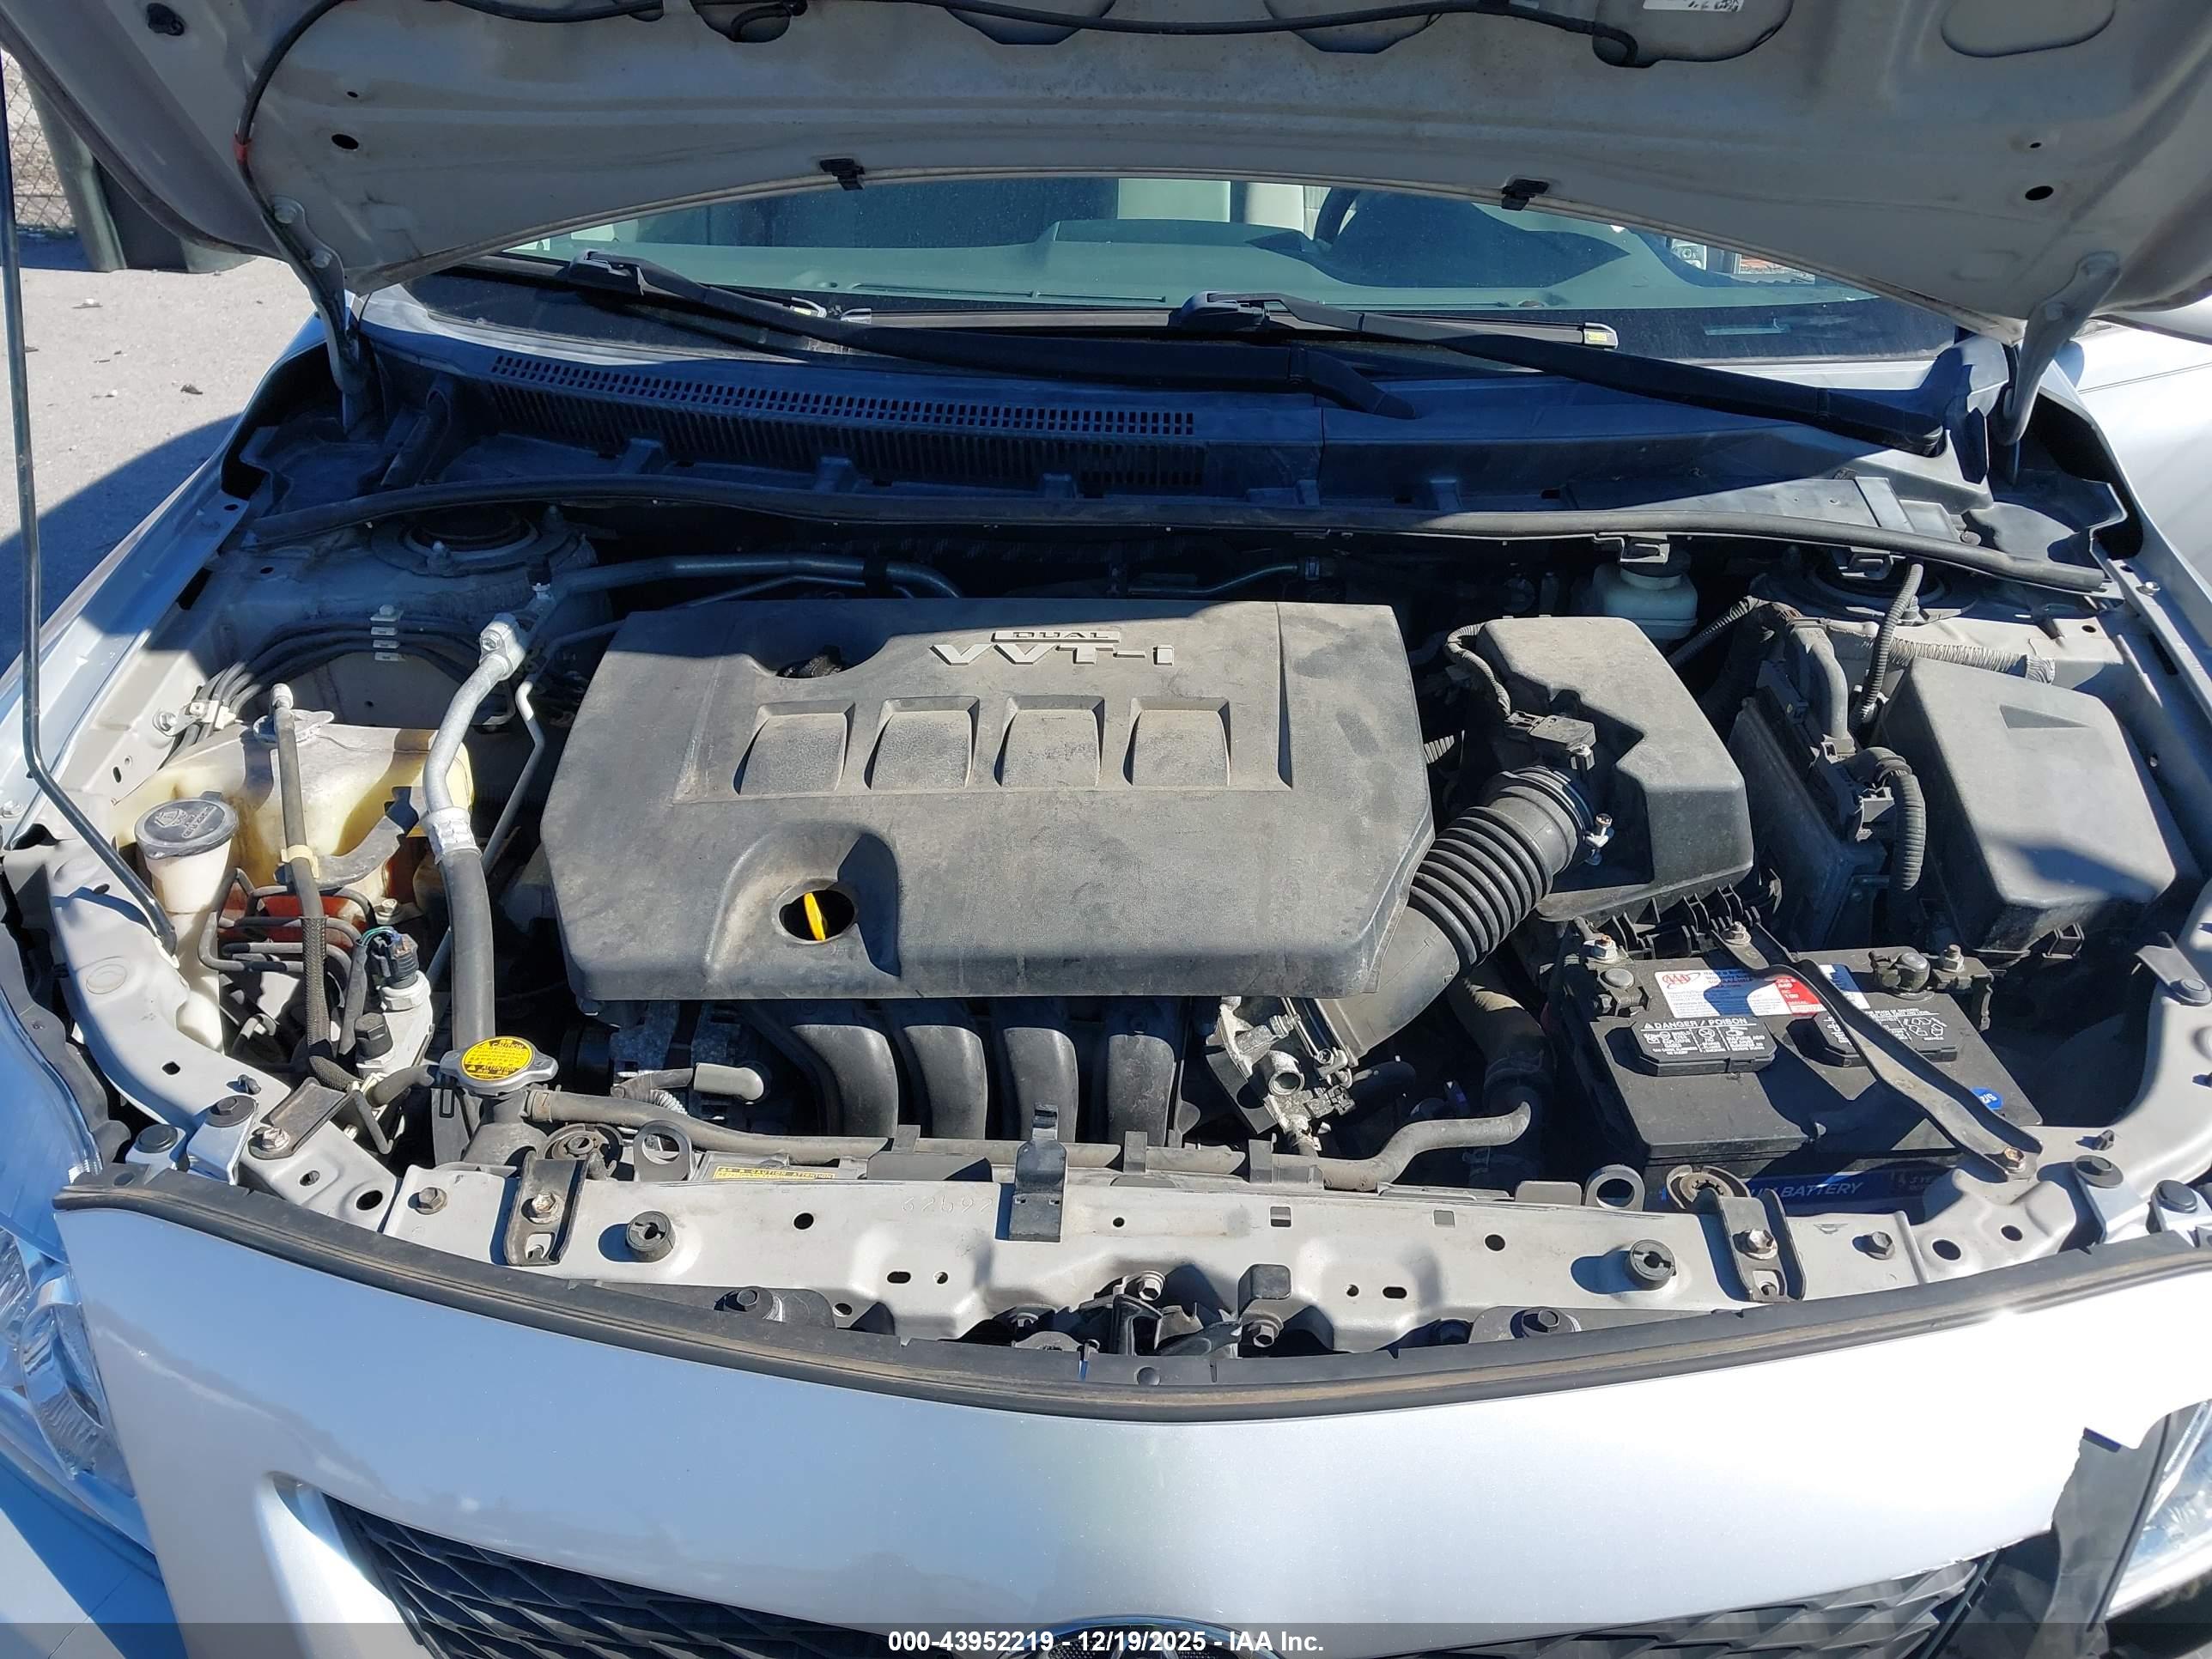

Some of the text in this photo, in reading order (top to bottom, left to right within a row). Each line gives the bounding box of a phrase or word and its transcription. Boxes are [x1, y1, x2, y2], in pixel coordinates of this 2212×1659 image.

[1662, 973, 1691, 985] AAA
[1654, 1020, 1698, 1030] DANGER
[1708, 1018, 1748, 1026] POISON
[1782, 1182, 1864, 1198] BATTERY
